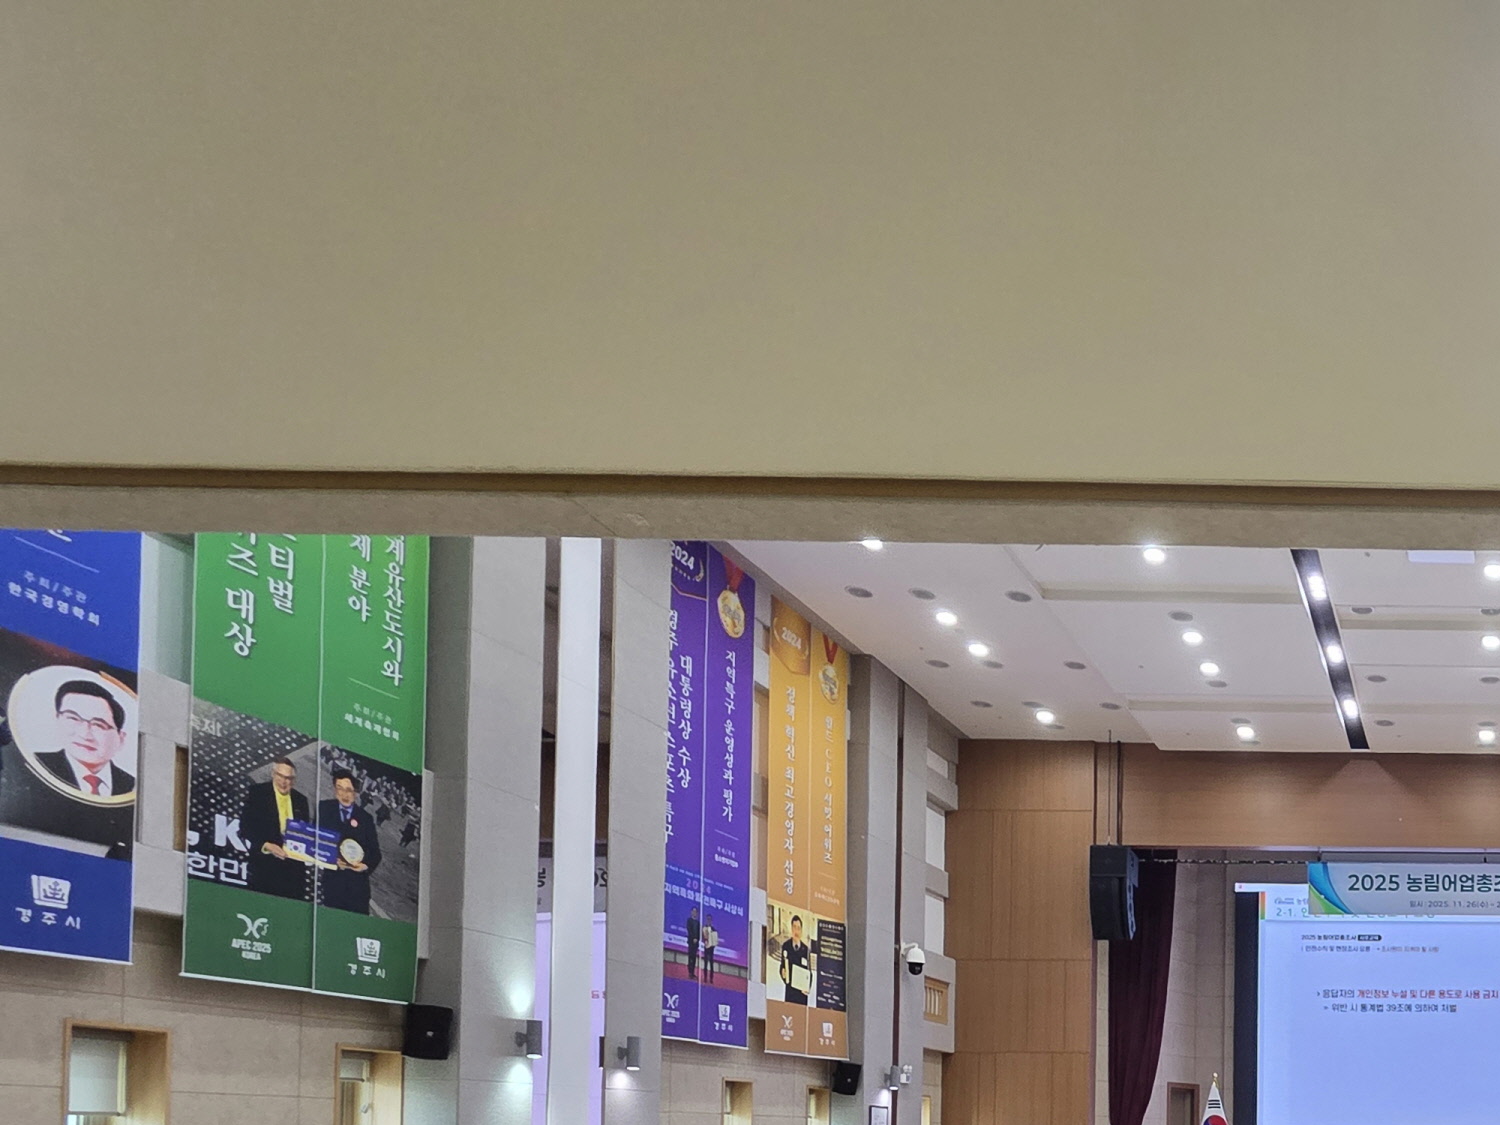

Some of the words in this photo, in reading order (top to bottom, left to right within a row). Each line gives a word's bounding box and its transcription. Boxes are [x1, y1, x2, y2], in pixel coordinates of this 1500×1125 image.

[349, 565, 372, 622] 분야
[224, 588, 257, 657] 대상
[781, 626, 802, 650] 2024
[678, 654, 693, 740] 대통령상
[724, 650, 736, 715] 지역특구
[677, 745, 692, 788] 수상
[722, 788, 734, 823] 평가
[783, 859, 794, 895] 선정
[1347, 873, 1400, 892] 2025
[15, 906, 81, 930] 경주시
[1322, 989, 1355, 998] 응답자의
[1357, 989, 1391, 998] 개인정보
[1391, 989, 1408, 999] 누설
[1420, 989, 1436, 999] 다른
[1438, 989, 1463, 999] 용도로
[1465, 989, 1481, 999] 사용
[1482, 989, 1499, 999] 금지
[1332, 1003, 1348, 1012] 위반
[1360, 1003, 1384, 1012] 통계법
[1385, 1003, 1412, 1012] 39조에
